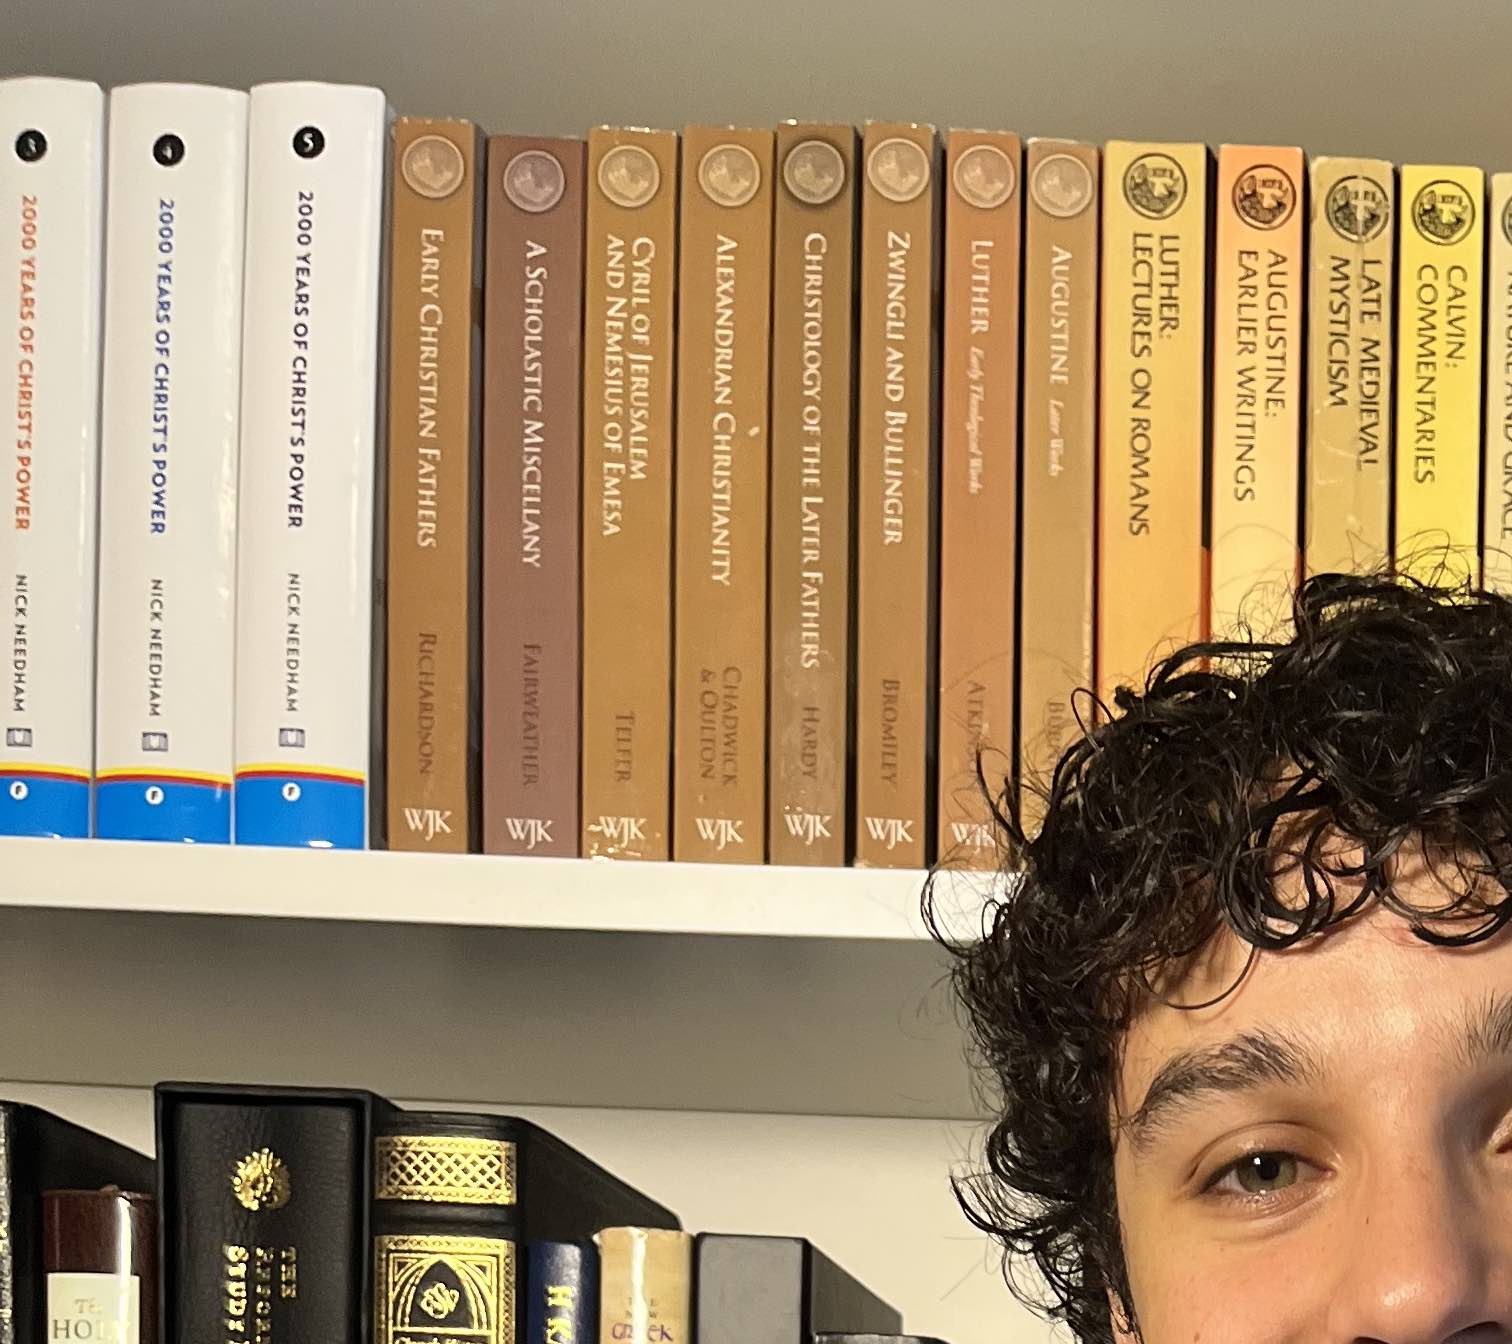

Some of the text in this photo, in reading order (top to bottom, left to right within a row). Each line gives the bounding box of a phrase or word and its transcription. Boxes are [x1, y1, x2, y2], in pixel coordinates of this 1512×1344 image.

[301, 134, 316, 152] 5
[287, 191, 313, 528] 2000 YEARS OF CHRIST'S POWER
[416, 228, 442, 547] EARLY CHRISTIAN FATHERS
[521, 240, 546, 567] A SCHOLASTIC MISCELLANY
[603, 235, 627, 536] AND NEMESIUS OF EMESA
[626, 236, 654, 480] CYRIL OF JERUSALEM
[710, 233, 738, 585] ALEXANDRIAN CHRISTIANITY
[883, 232, 911, 545] ZWINGLI AND BULLINGER
[1234, 250, 1258, 502] EARLIER WRITINGS
[1266, 249, 1287, 418] AUGUSTINE:
[1328, 256, 1349, 407] MYSTICISM
[1358, 259, 1381, 471] LATE MEDIEVAL
[1414, 265, 1437, 485] COMMENTARIES
[1445, 265, 1467, 369] CALVIN:
[286, 573, 300, 712] NICK NEEDHAM
[404, 809, 451, 841] WJK
[695, 819, 744, 845] WJK
